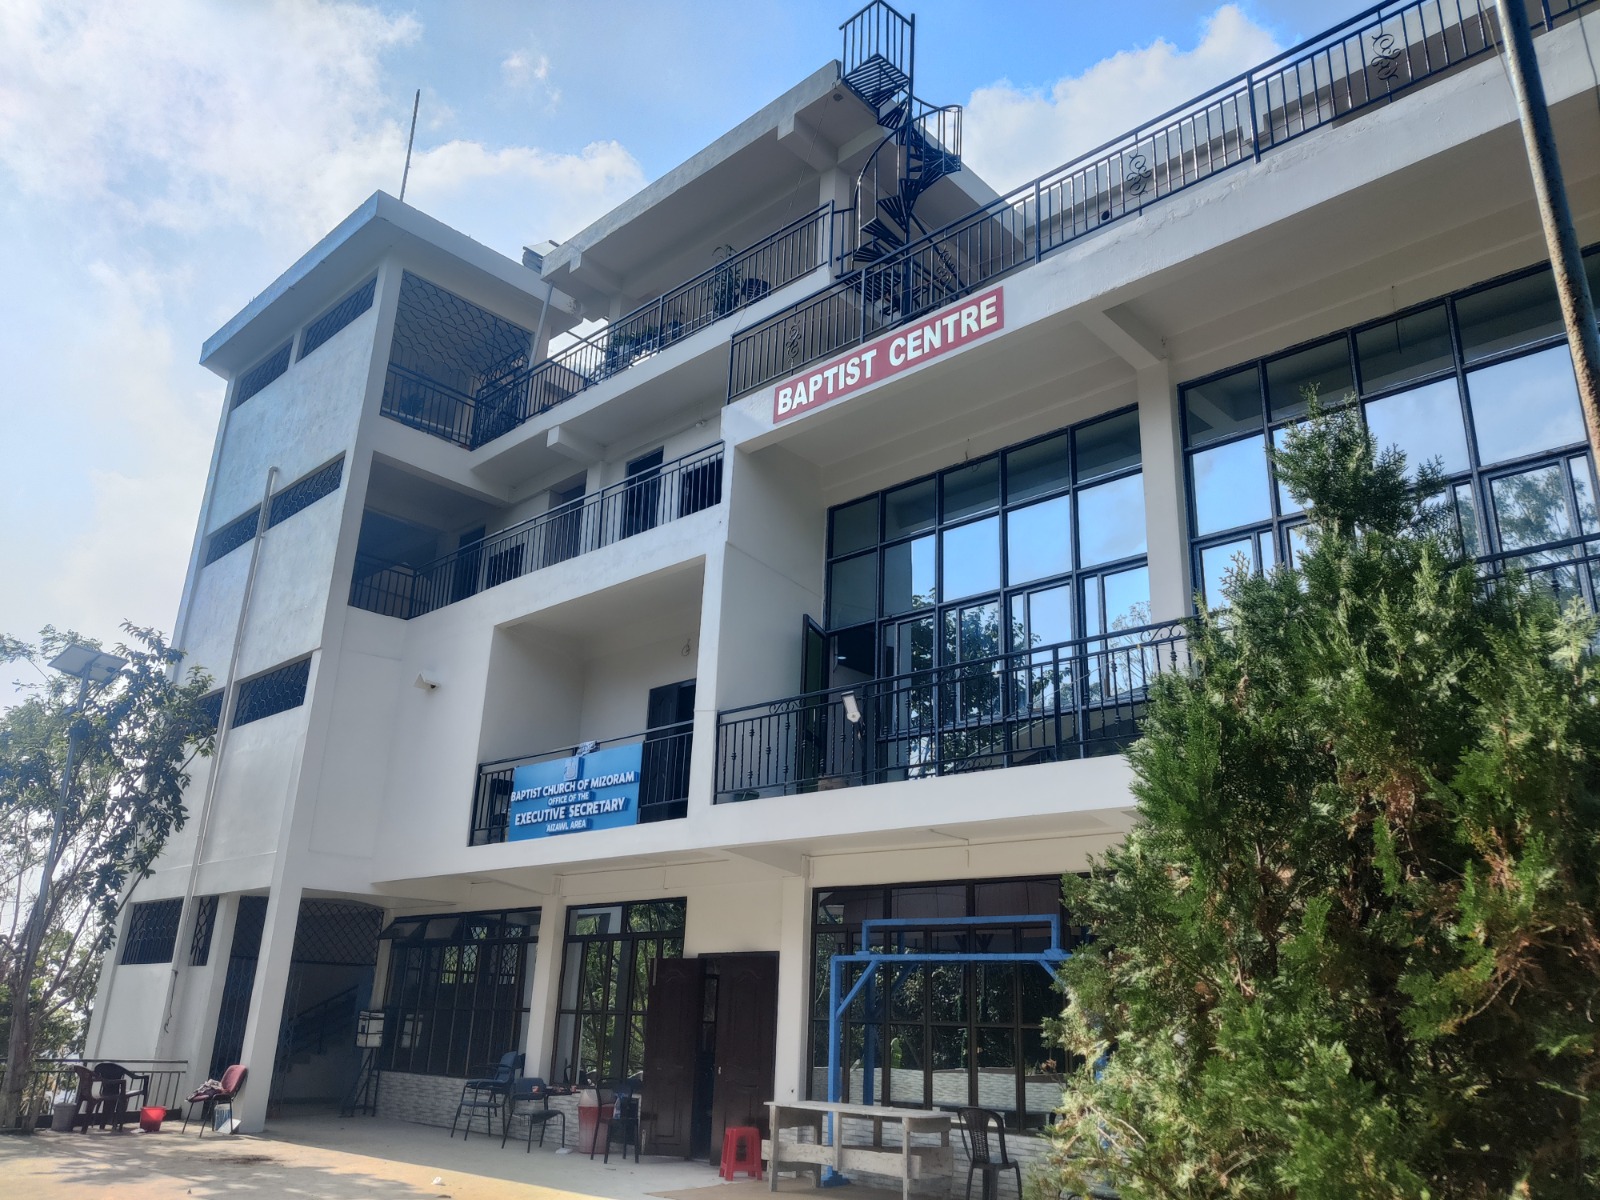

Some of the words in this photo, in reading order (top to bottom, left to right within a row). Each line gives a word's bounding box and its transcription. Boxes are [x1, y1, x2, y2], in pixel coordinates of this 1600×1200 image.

[777, 349, 877, 416] BAPTIST
[889, 295, 998, 367] CENTRE
[511, 787, 541, 801] BAPTIST
[542, 780, 576, 797] CHURCH
[577, 778, 589, 790] OF
[590, 771, 634, 788] MIZORAM
[548, 795, 568, 805] OFFICE
[568, 793, 577, 801] OF
[578, 791, 589, 801] THE
[515, 807, 565, 826] EXECUTIVE
[569, 797, 625, 817] SECRETARY
[546, 822, 568, 833] AIZAWL
[570, 819, 586, 829] AREA
